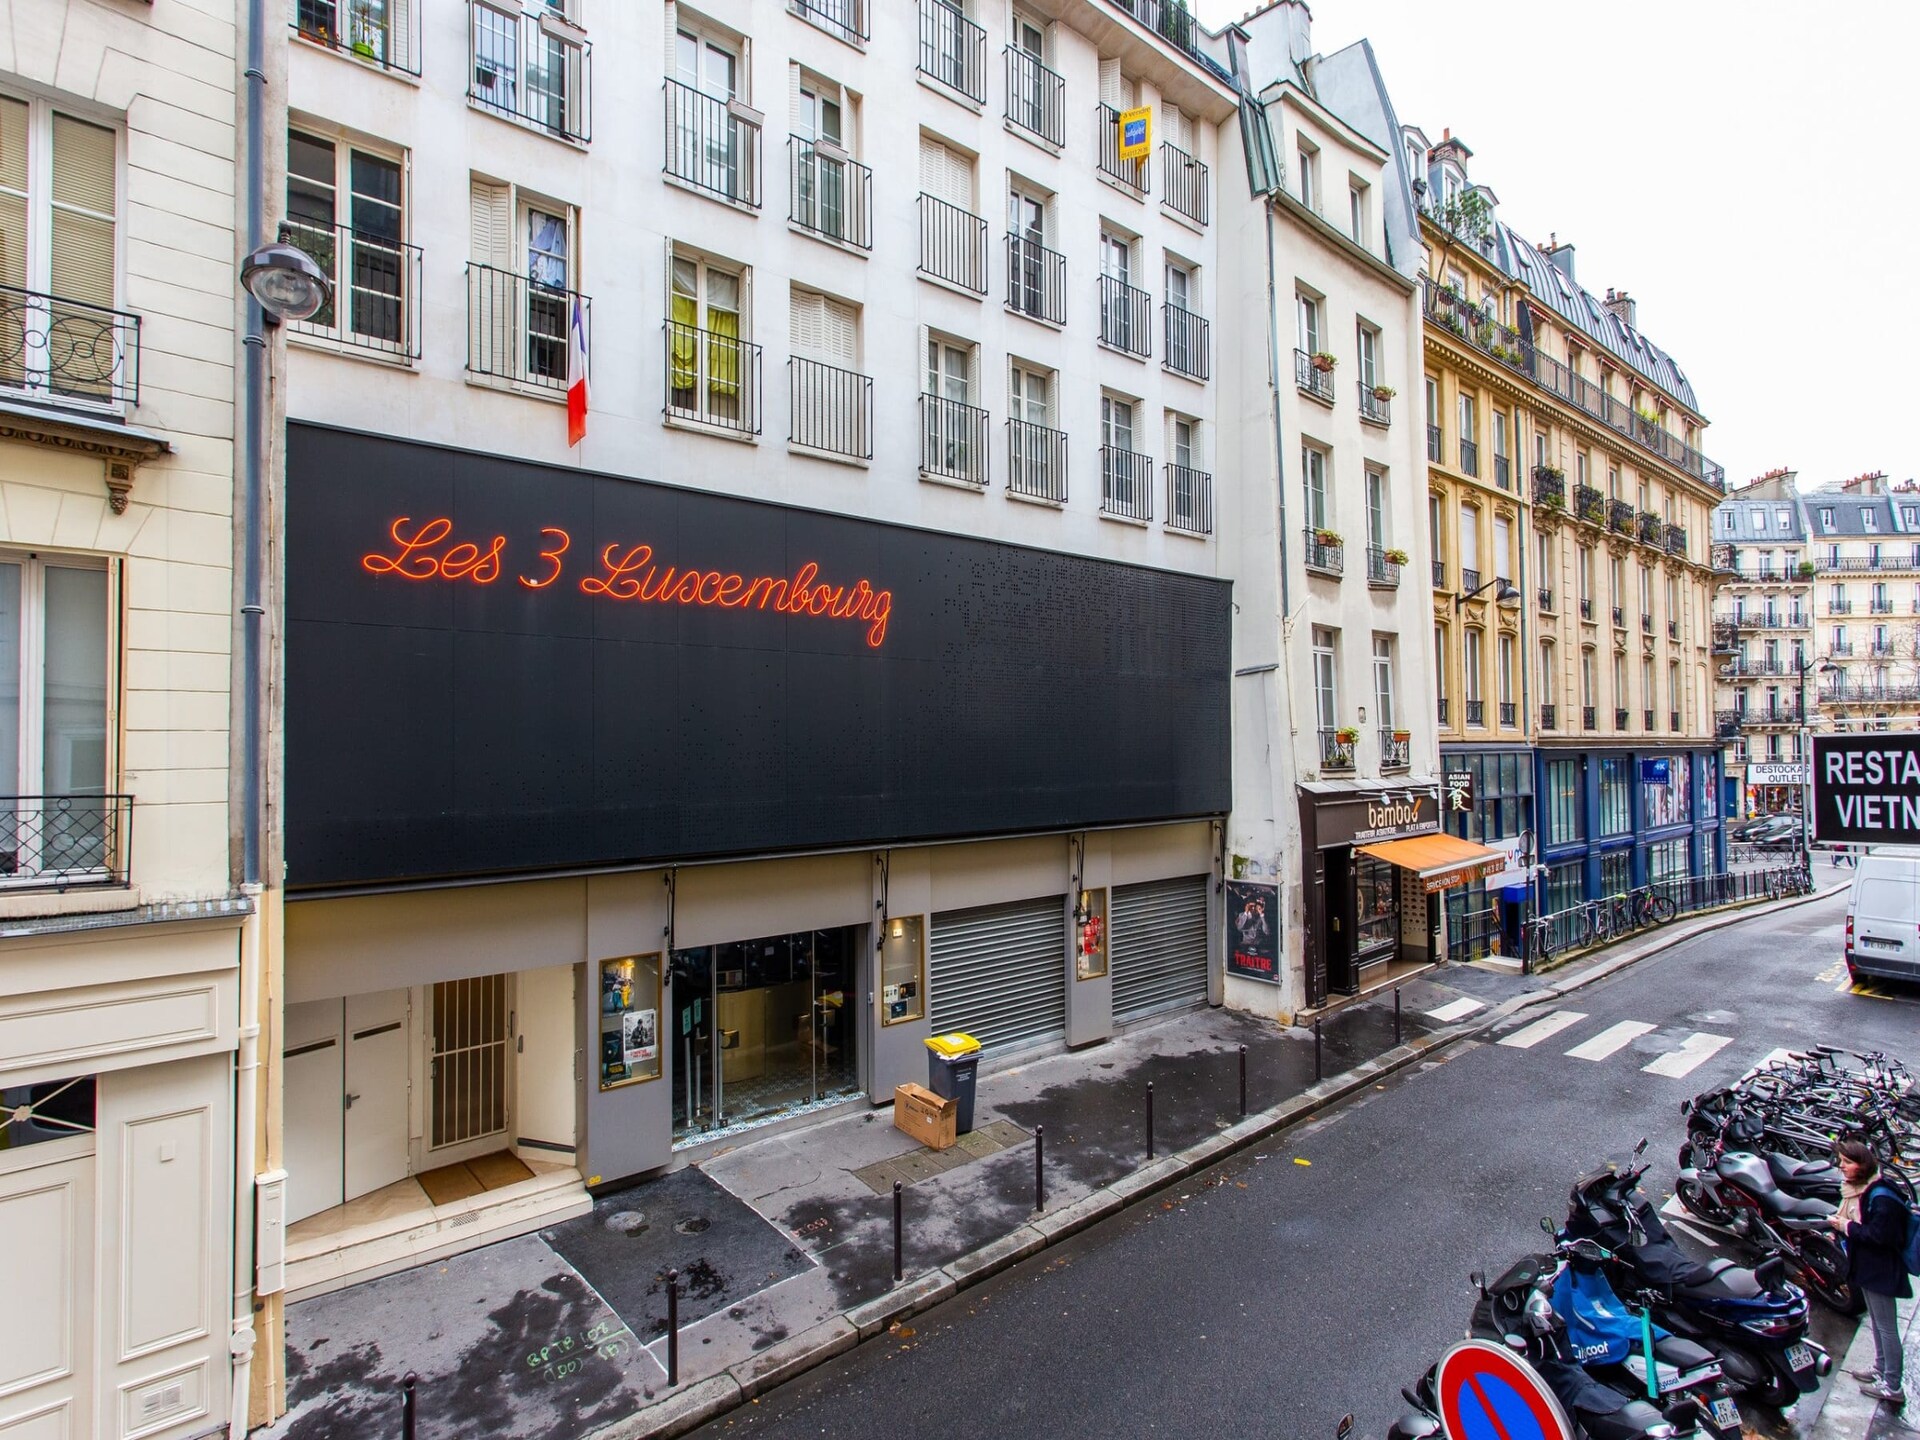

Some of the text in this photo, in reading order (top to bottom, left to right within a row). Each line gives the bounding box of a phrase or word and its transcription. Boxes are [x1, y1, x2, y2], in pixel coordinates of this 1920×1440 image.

[362, 517, 892, 648] Les 3 Luxembourg
[1448, 773, 1471, 781] ASIAN
[1768, 774, 1803, 783] OUTLET
[1825, 750, 1920, 785] RESTA
[1834, 794, 1920, 830] VIETN
[1426, 879, 1442, 891] SERVICE
[1442, 877, 1451, 887] NON
